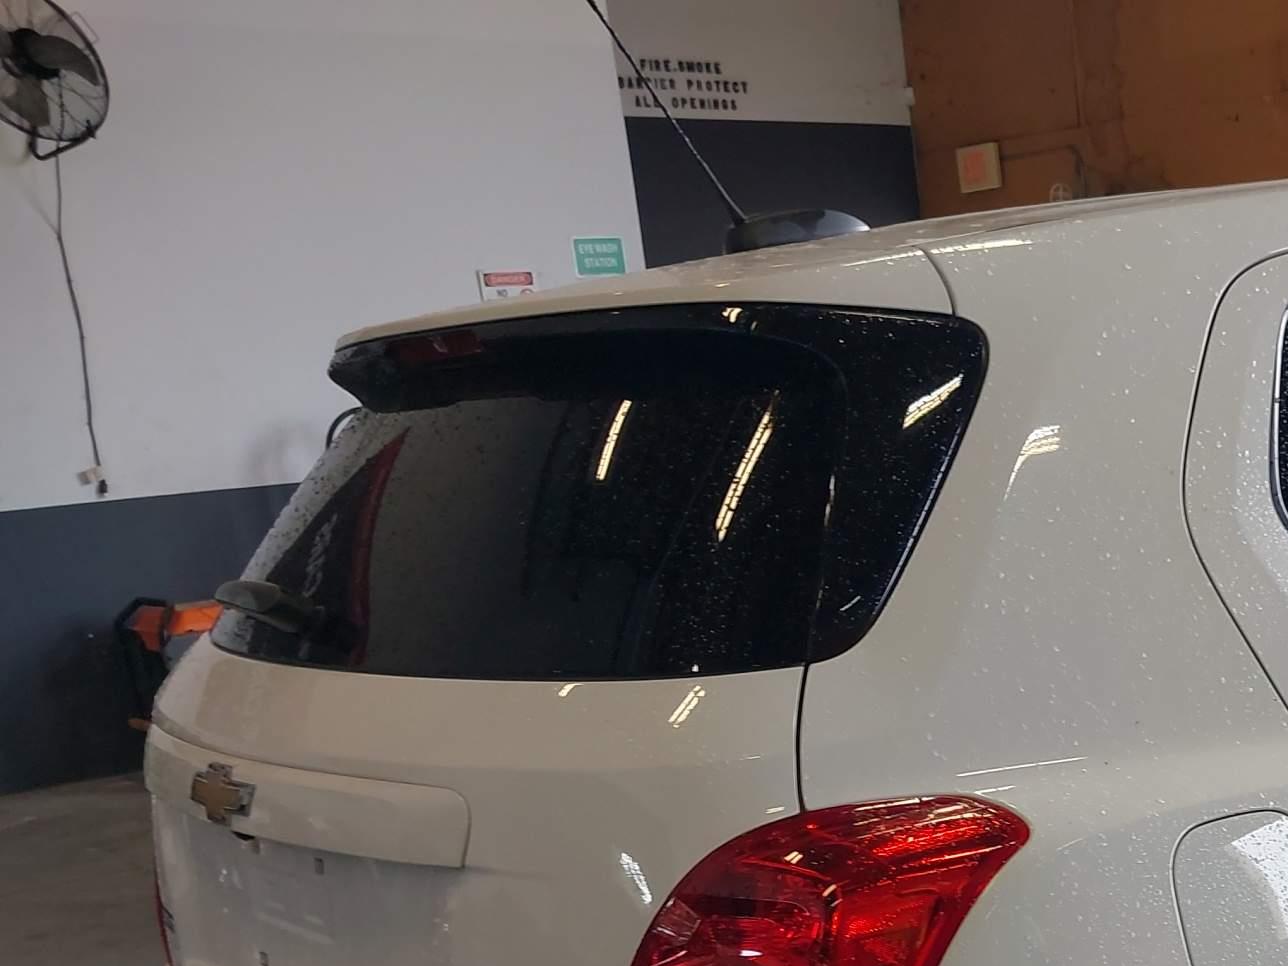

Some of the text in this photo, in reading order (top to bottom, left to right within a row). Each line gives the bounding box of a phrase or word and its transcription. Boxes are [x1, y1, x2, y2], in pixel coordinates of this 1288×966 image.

[687, 79, 748, 94] PROTECT
[671, 96, 738, 111] OPENINGS
[584, 257, 619, 268] STATION
